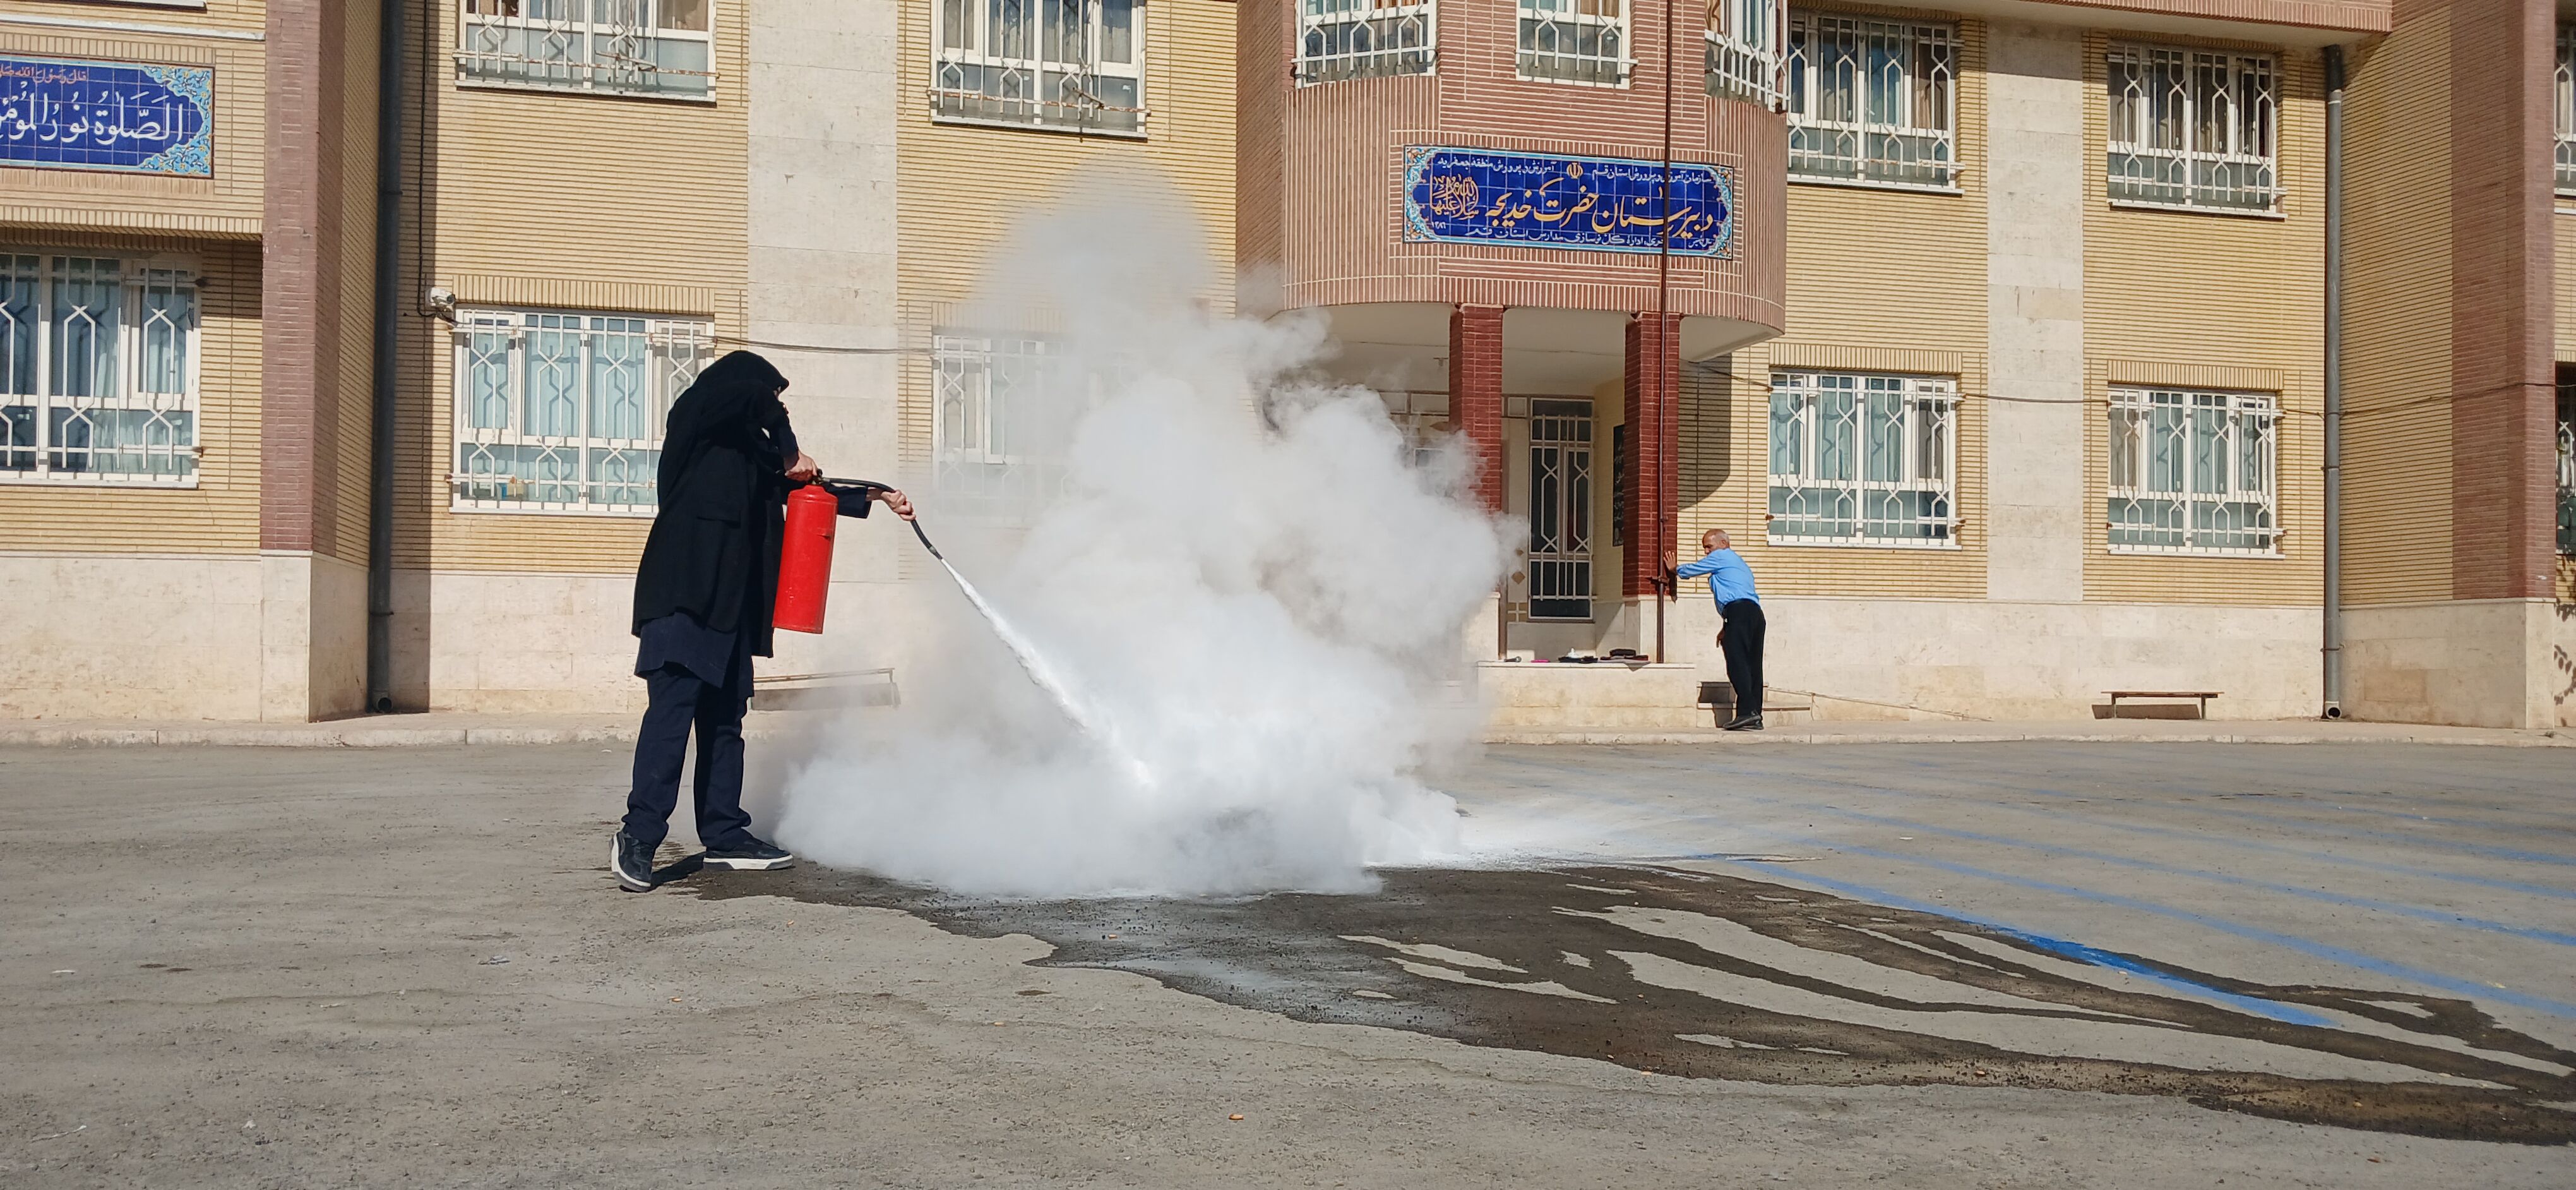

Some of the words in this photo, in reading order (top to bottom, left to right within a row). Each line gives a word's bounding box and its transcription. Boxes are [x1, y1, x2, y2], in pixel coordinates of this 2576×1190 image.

[1493, 159, 1522, 176] پرورش
[1528, 160, 1557, 175] آموزش
[1592, 165, 1609, 181] قم
[1485, 189, 1532, 228] خدیجه
[1532, 184, 1600, 228] حضرت
[1591, 189, 1714, 237] دبیرستان
